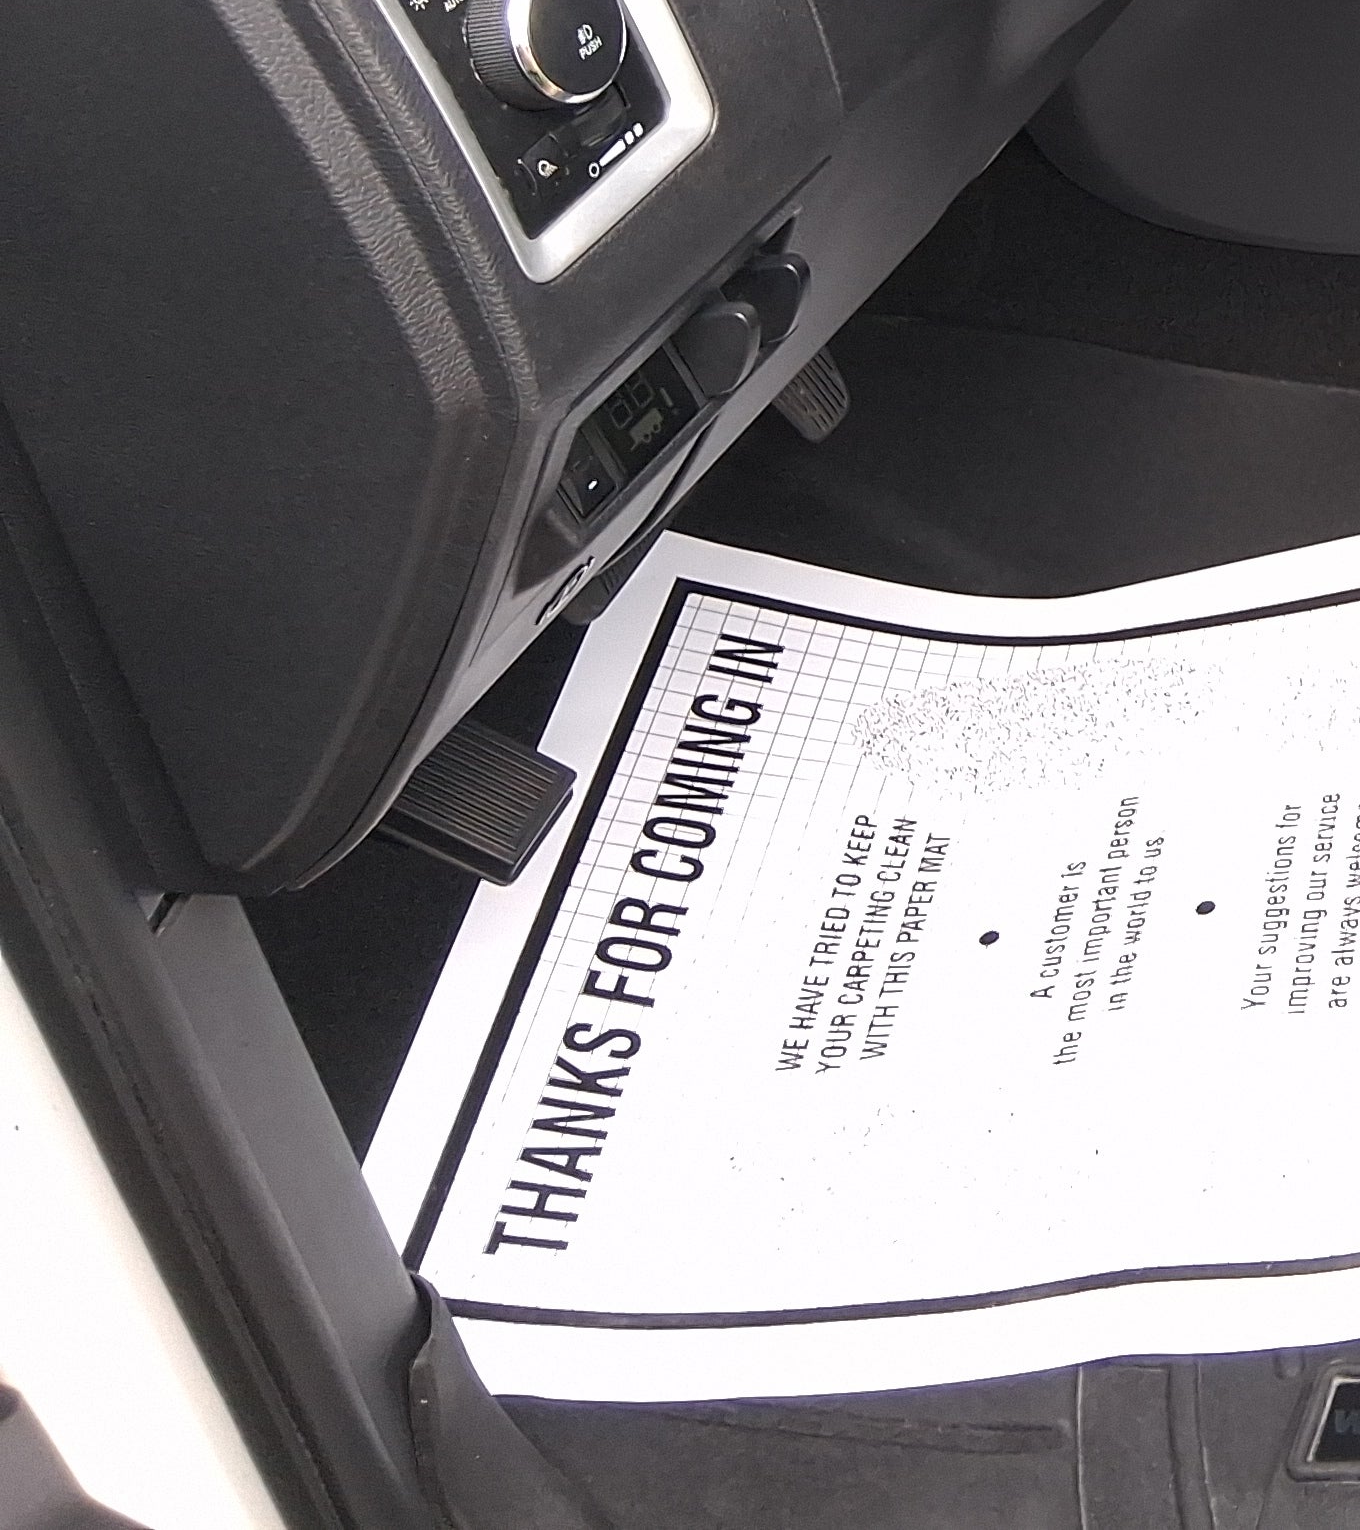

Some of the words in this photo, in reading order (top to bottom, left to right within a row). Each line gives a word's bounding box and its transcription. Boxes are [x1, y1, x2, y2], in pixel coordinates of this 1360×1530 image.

[578, 37, 603, 60] PUSH
[708, 632, 785, 684] IN
[629, 693, 764, 883] COMING
[842, 814, 877, 865] KEEP
[1107, 796, 1140, 860] person
[1275, 804, 1302, 829] for
[1312, 792, 1341, 864] service
[918, 832, 951, 872] MAT
[1061, 861, 1087, 879] is
[1144, 835, 1165, 859] us
[832, 873, 862, 898] TO
[1133, 866, 1158, 886] to
[1257, 836, 1297, 956] suggestions
[1306, 870, 1328, 901] our
[809, 907, 850, 967] TRIED
[895, 880, 938, 944] PAPER
[1040, 886, 1080, 979] customer
[1082, 866, 1123, 963] important
[1123, 889, 1152, 945] world
[580, 896, 688, 1009] FOR
[815, 1014, 857, 1075] YOUR
[837, 890, 896, 1006] CARPETING
[876, 818, 917, 883] CLEAN
[1109, 952, 1138, 986] the
[1288, 909, 1328, 1014] improving
[879, 951, 916, 999] THIS
[1029, 985, 1055, 999] A
[1068, 969, 1097, 1022] most
[1240, 963, 1273, 1011] Your
[1328, 976, 1351, 1009] are
[789, 975, 830, 1030] HAVE
[1107, 991, 1129, 1011] in
[775, 1039, 809, 1071] WE
[859, 1005, 899, 1061] WITH
[1053, 1031, 1082, 1066] the
[483, 1022, 642, 1255] THANKS
